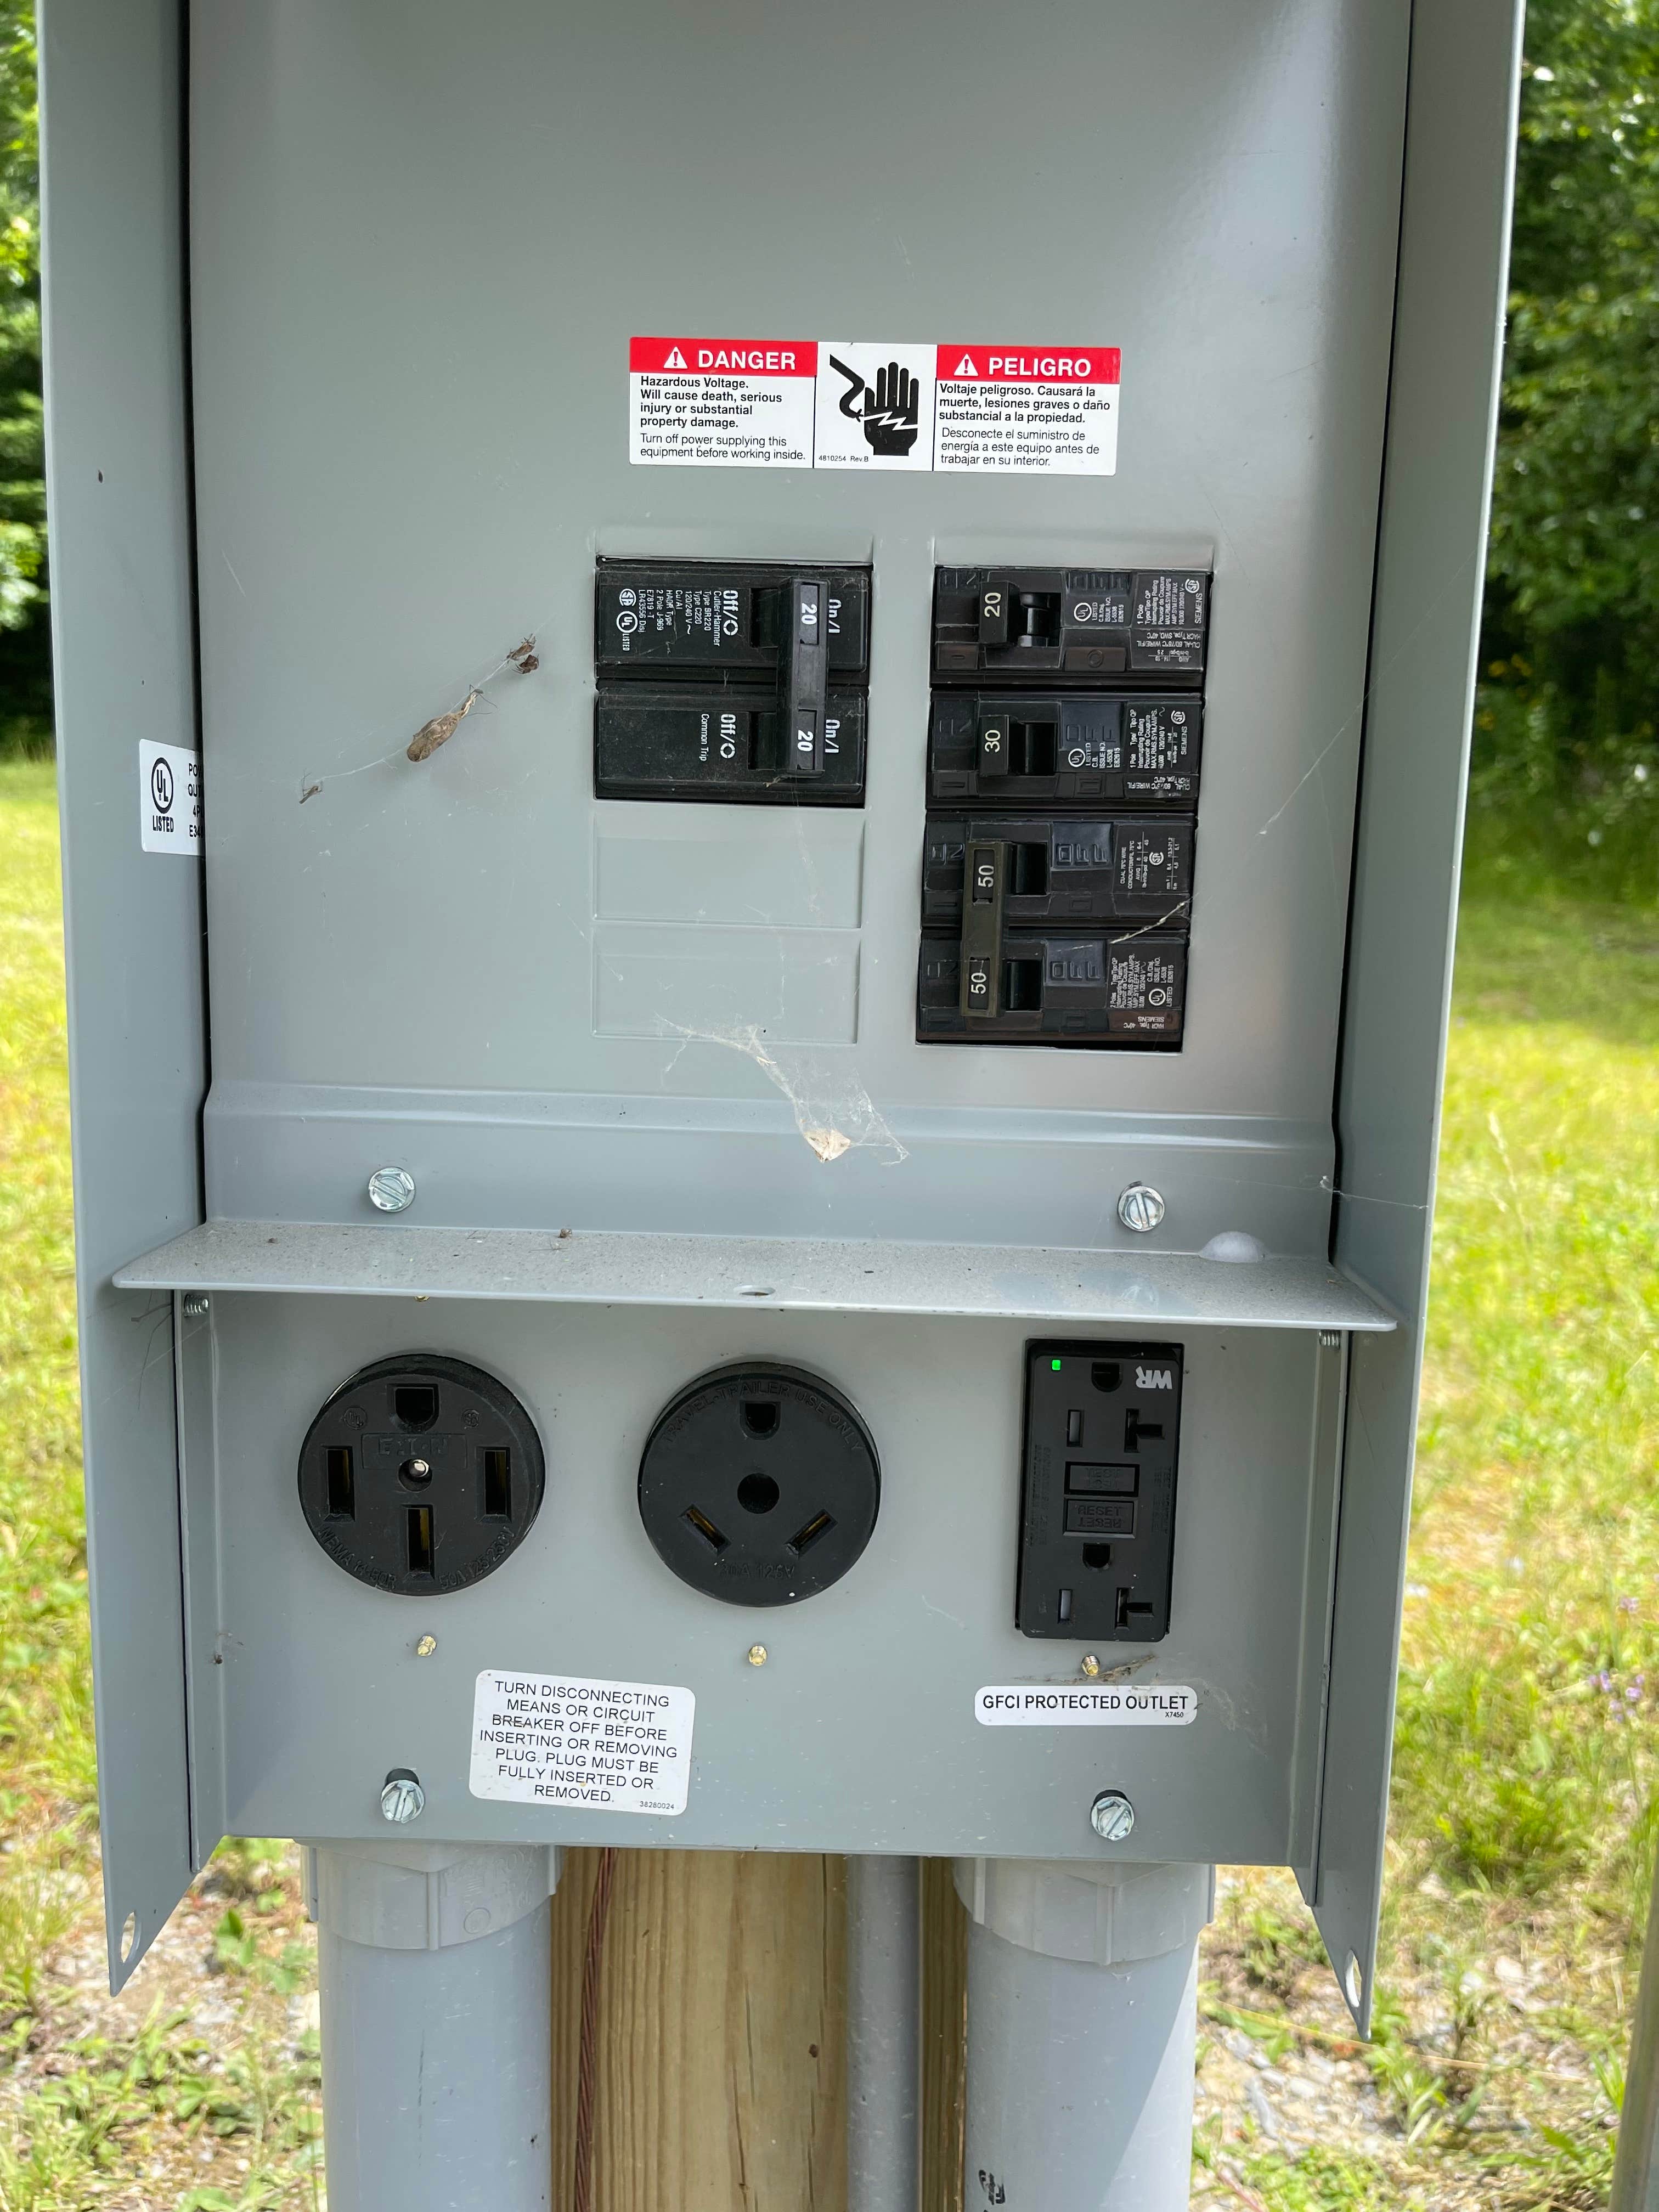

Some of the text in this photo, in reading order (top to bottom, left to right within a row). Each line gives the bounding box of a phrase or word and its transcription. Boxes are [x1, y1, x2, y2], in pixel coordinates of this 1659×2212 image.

[698, 350, 795, 370] DANGER
[989, 357, 1091, 377] PELIGRO
[641, 376, 748, 390] Hazardous Voltage.
[940, 383, 1095, 396] Voltaje peligroso. Causará la
[641, 390, 782, 403] Will cause death, serious
[940, 398, 981, 409] muerte,
[985, 398, 1030, 408] lesiones
[1033, 401, 1069, 410] graves
[1083, 400, 1110, 410] daño
[641, 403, 672, 415] injury
[690, 405, 752, 415] substantial
[939, 411, 1001, 421] substancial
[1015, 412, 1023, 421] la
[1027, 413, 1085, 424] propiedad.
[641, 417, 738, 429] property damage.
[641, 433, 786, 448] Turn off power supplying this
[942, 427, 1085, 441] Desconecte el suministro de
[641, 448, 805, 460] equipment before working inside.
[941, 441, 979, 453] energía
[992, 443, 1013, 452] este
[1017, 444, 1052, 455] equipo
[1055, 445, 1082, 454] antes
[1087, 444, 1099, 454] de
[941, 455, 980, 466] trabajar
[1014, 455, 1050, 466] interior.
[693, 590, 702, 605] Type
[984, 592, 1001, 618] 20
[665, 611, 674, 625] Type
[801, 602, 818, 625] 20
[699, 714, 710, 761] Common Trip
[797, 731, 814, 753] 20
[984, 729, 1001, 753] 30
[153, 815, 174, 832] LISTED
[1057, 843, 1108, 863] OFF
[977, 864, 994, 888] 50
[1050, 960, 1101, 980] OFF
[971, 972, 988, 994] 50
[1136, 1366, 1172, 1390] WR
[795, 1388, 831, 1414] USE
[828, 1413, 864, 1451] ONLY
[495, 1680, 669, 1707] TURN DISCONNECTING
[983, 1695, 1188, 1709] GFCI PROTECTED OUTLET
[507, 1699, 655, 1723] MEANS OR CIRCUIT
[493, 1714, 667, 1741] BREAKER OFF BEFORE
[480, 1729, 678, 1758] INSERTING OR REMOVING
[496, 1748, 659, 1773] PLUG. PLUG MUST BE
[499, 1765, 654, 1790] FULLY INSERTED OR
[535, 1785, 615, 1802] REMOVED.
[640, 1801, 675, 1809] 38280024
